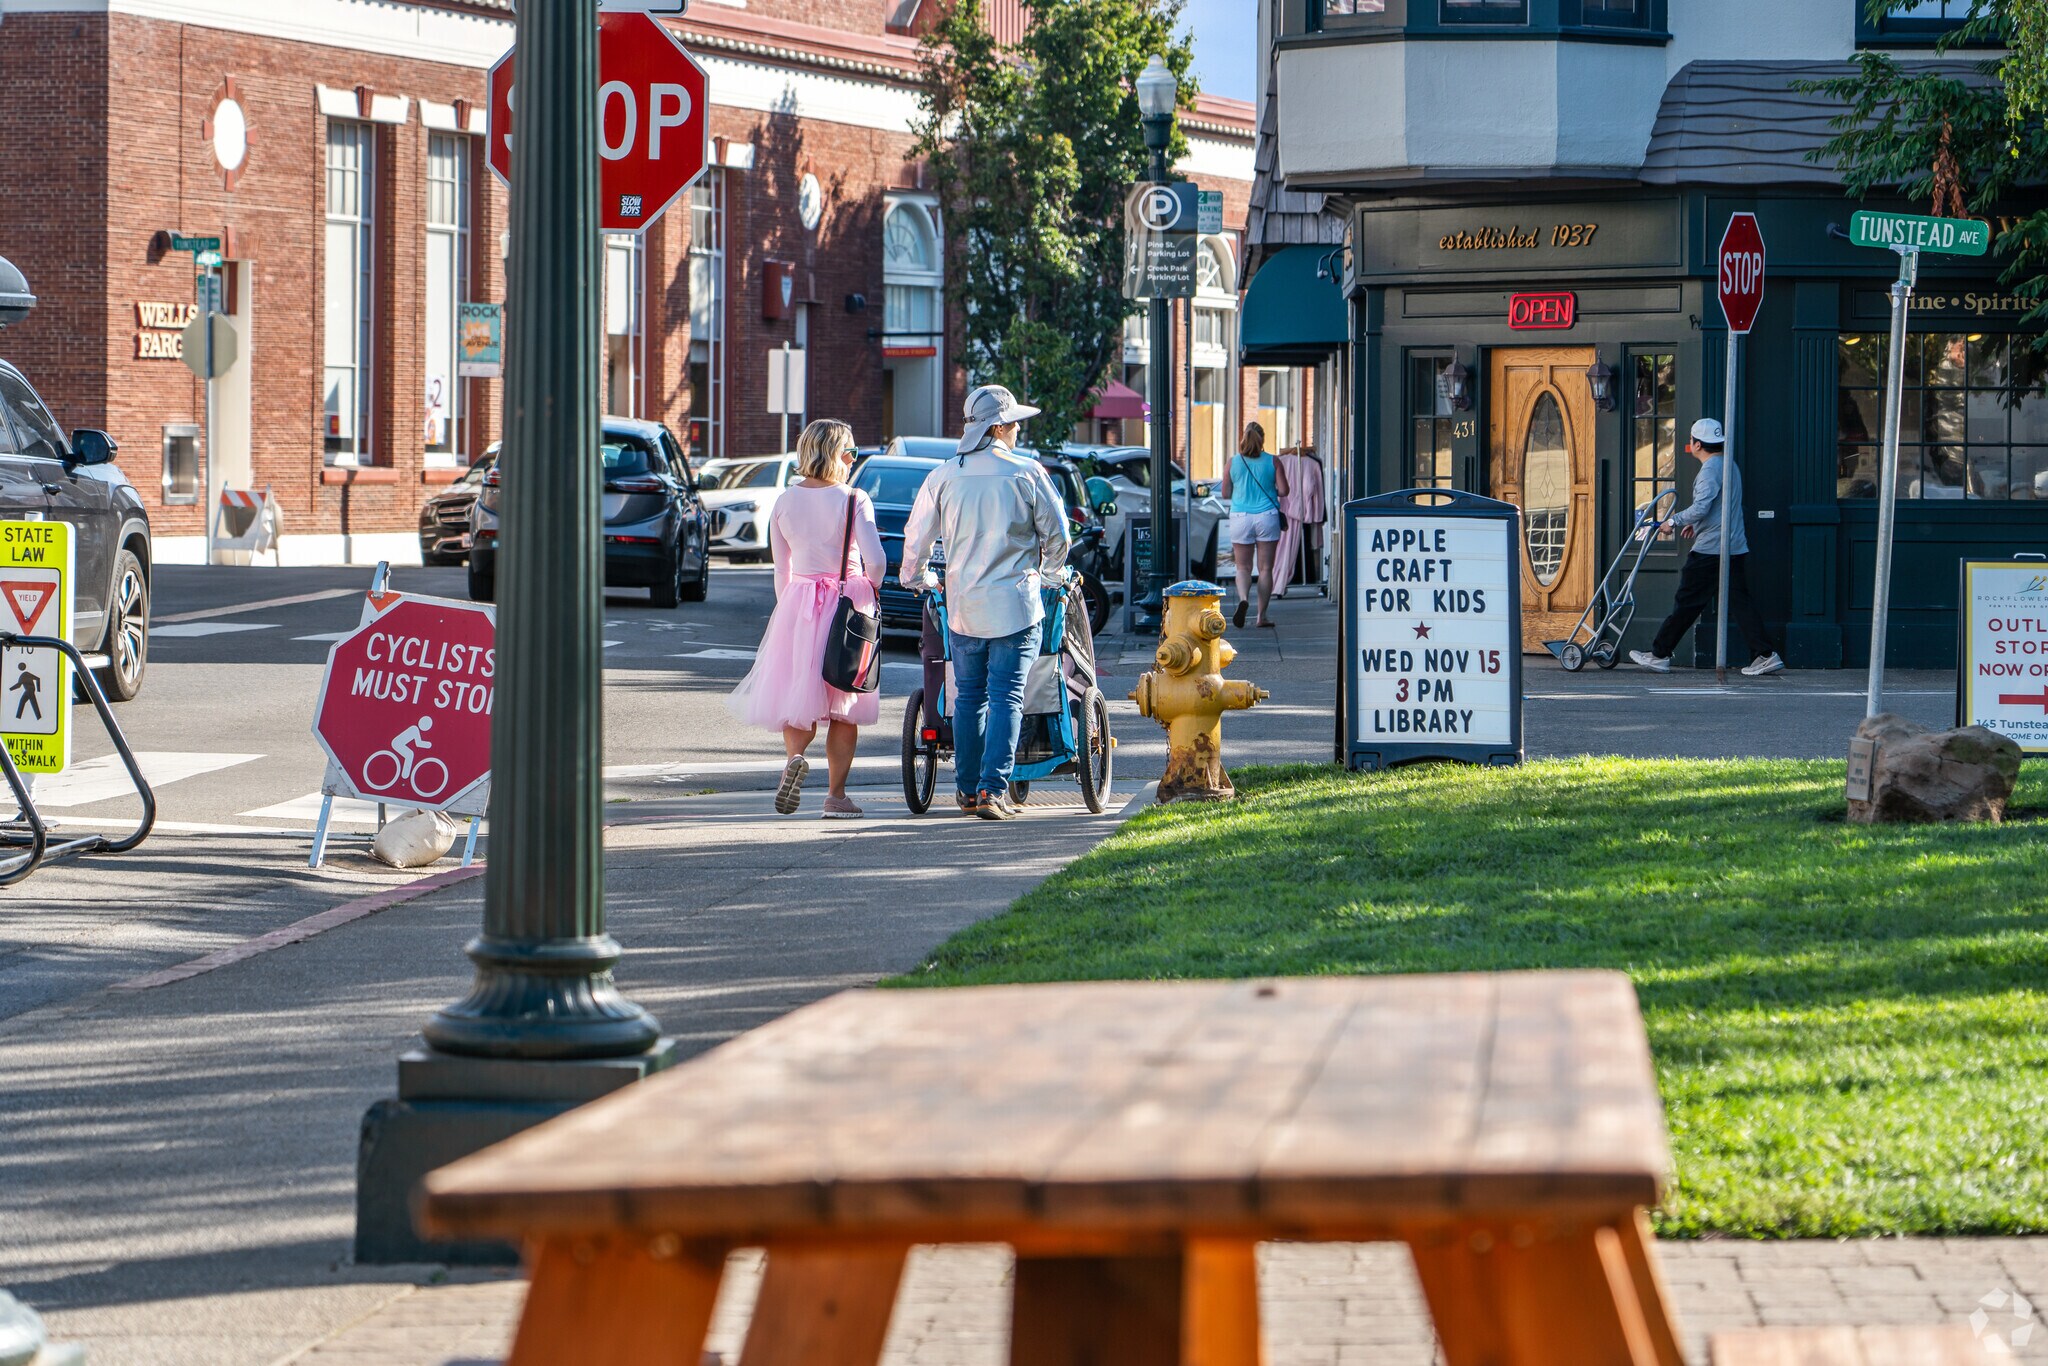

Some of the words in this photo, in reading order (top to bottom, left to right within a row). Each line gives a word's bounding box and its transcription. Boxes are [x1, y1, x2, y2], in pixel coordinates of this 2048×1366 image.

[621, 197, 642, 206] SLOW
[1198, 192, 1206, 204] 2
[621, 206, 641, 215] BOYS
[1439, 225, 1538, 249] established
[1551, 224, 1597, 247] 1937
[1860, 216, 1955, 248] TUNSTEAD
[1959, 230, 1980, 245] AVE
[1147, 250, 1176, 258] Parking
[1147, 264, 1169, 272] Creek
[1722, 252, 1761, 295] STOP
[1147, 273, 1176, 282] Parking
[462, 306, 500, 318] ROCK
[1512, 299, 1570, 323] OPEN
[1964, 292, 2040, 315] Spirits
[138, 301, 199, 329] WELLS
[138, 332, 184, 358] FARG
[1453, 420, 1475, 438] 431
[4, 528, 53, 543] STATE
[1371, 529, 1447, 552] APPLE
[12, 547, 45, 562] LAW
[1377, 558, 1453, 582] CRAFT
[18, 594, 37, 602] YIELD
[1366, 588, 1411, 612] FOR
[1433, 589, 1486, 613] KIDS
[1988, 618, 2048, 633] OUTL
[366, 632, 496, 678] CYCLISTS
[1362, 649, 1413, 673] WED
[1425, 649, 1469, 673] NOV
[1478, 650, 1500, 674] 15
[1979, 663, 2024, 677] NOW
[351, 667, 428, 704] MUST
[1396, 678, 1409, 702] 3
[1417, 679, 1454, 702] PM
[1374, 709, 1473, 733] LIBRARY
[1976, 719, 1997, 729] 145
[7, 738, 43, 751] WITHIN
[9, 753, 57, 767] SSWALK
